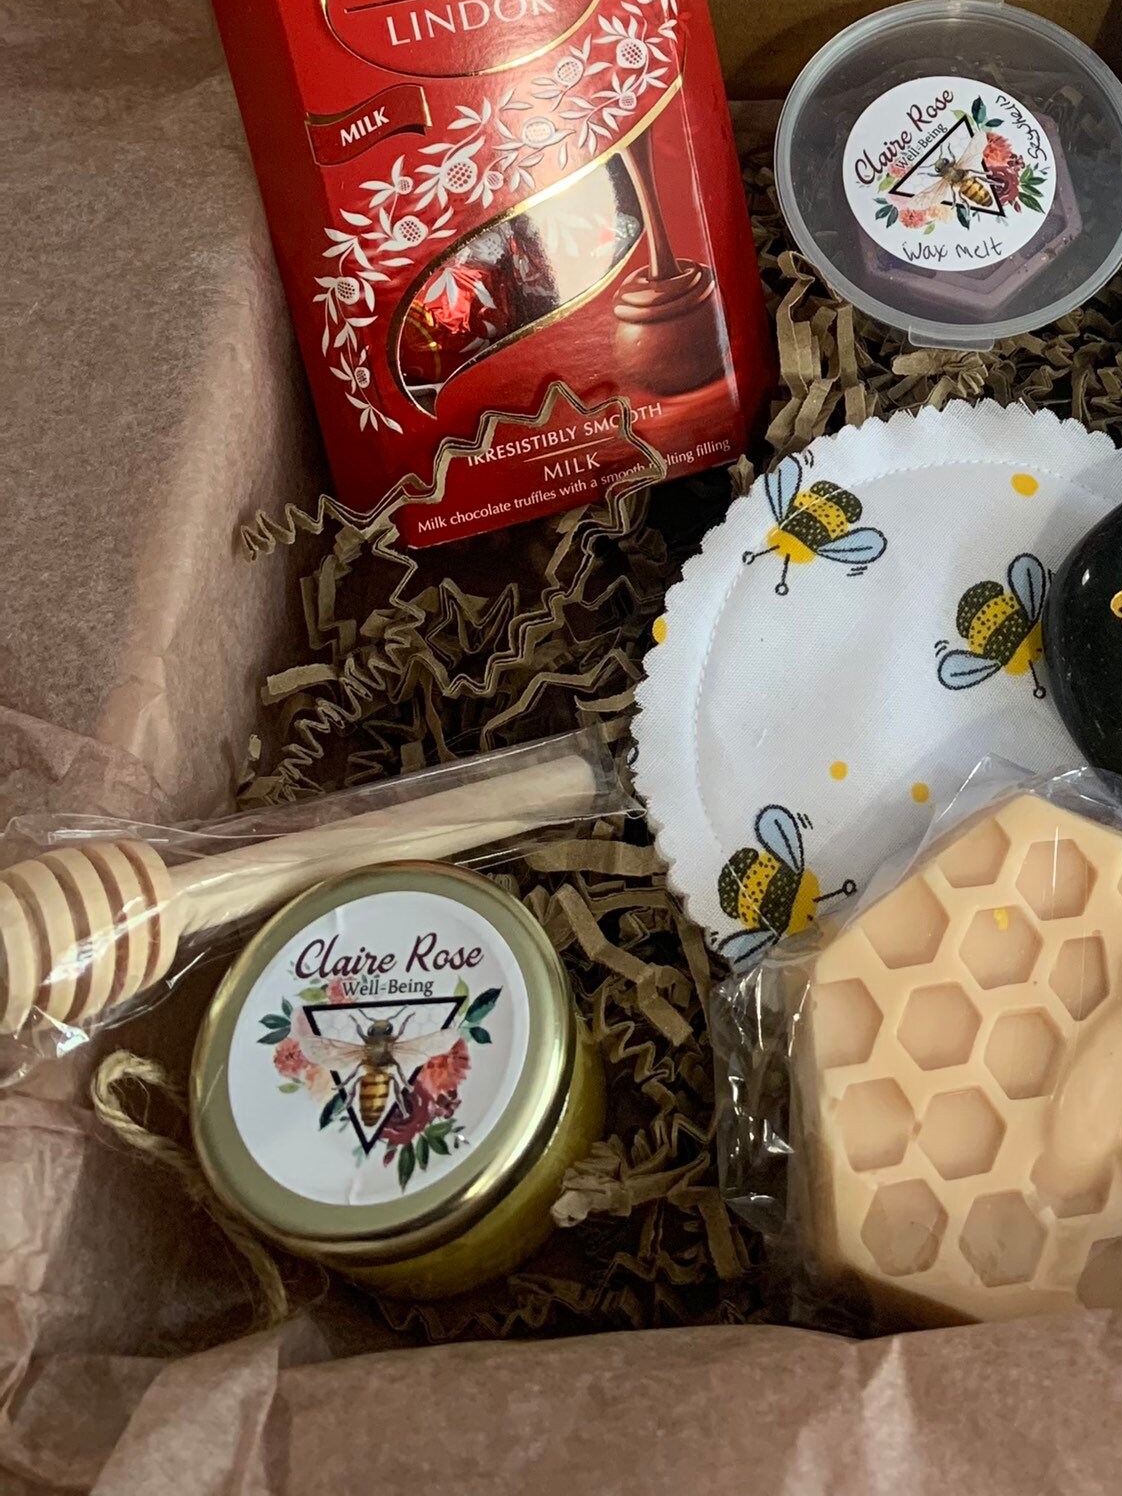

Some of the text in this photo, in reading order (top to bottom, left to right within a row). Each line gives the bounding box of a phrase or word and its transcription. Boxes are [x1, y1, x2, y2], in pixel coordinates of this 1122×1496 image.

[339, 105, 390, 148] MILK
[854, 89, 955, 186] Claire Rose
[895, 123, 949, 170] Well-Being
[467, 424, 577, 467] IRRESISTIBLY
[543, 451, 601, 483] MILK
[417, 515, 448, 534] Milk
[450, 499, 512, 526] chocolate
[514, 484, 558, 507] truffles
[559, 478, 588, 499] with
[590, 479, 599, 489] a
[696, 437, 732, 459] filling
[295, 932, 485, 980] Claire Rose
[341, 978, 435, 998] Well-Being
